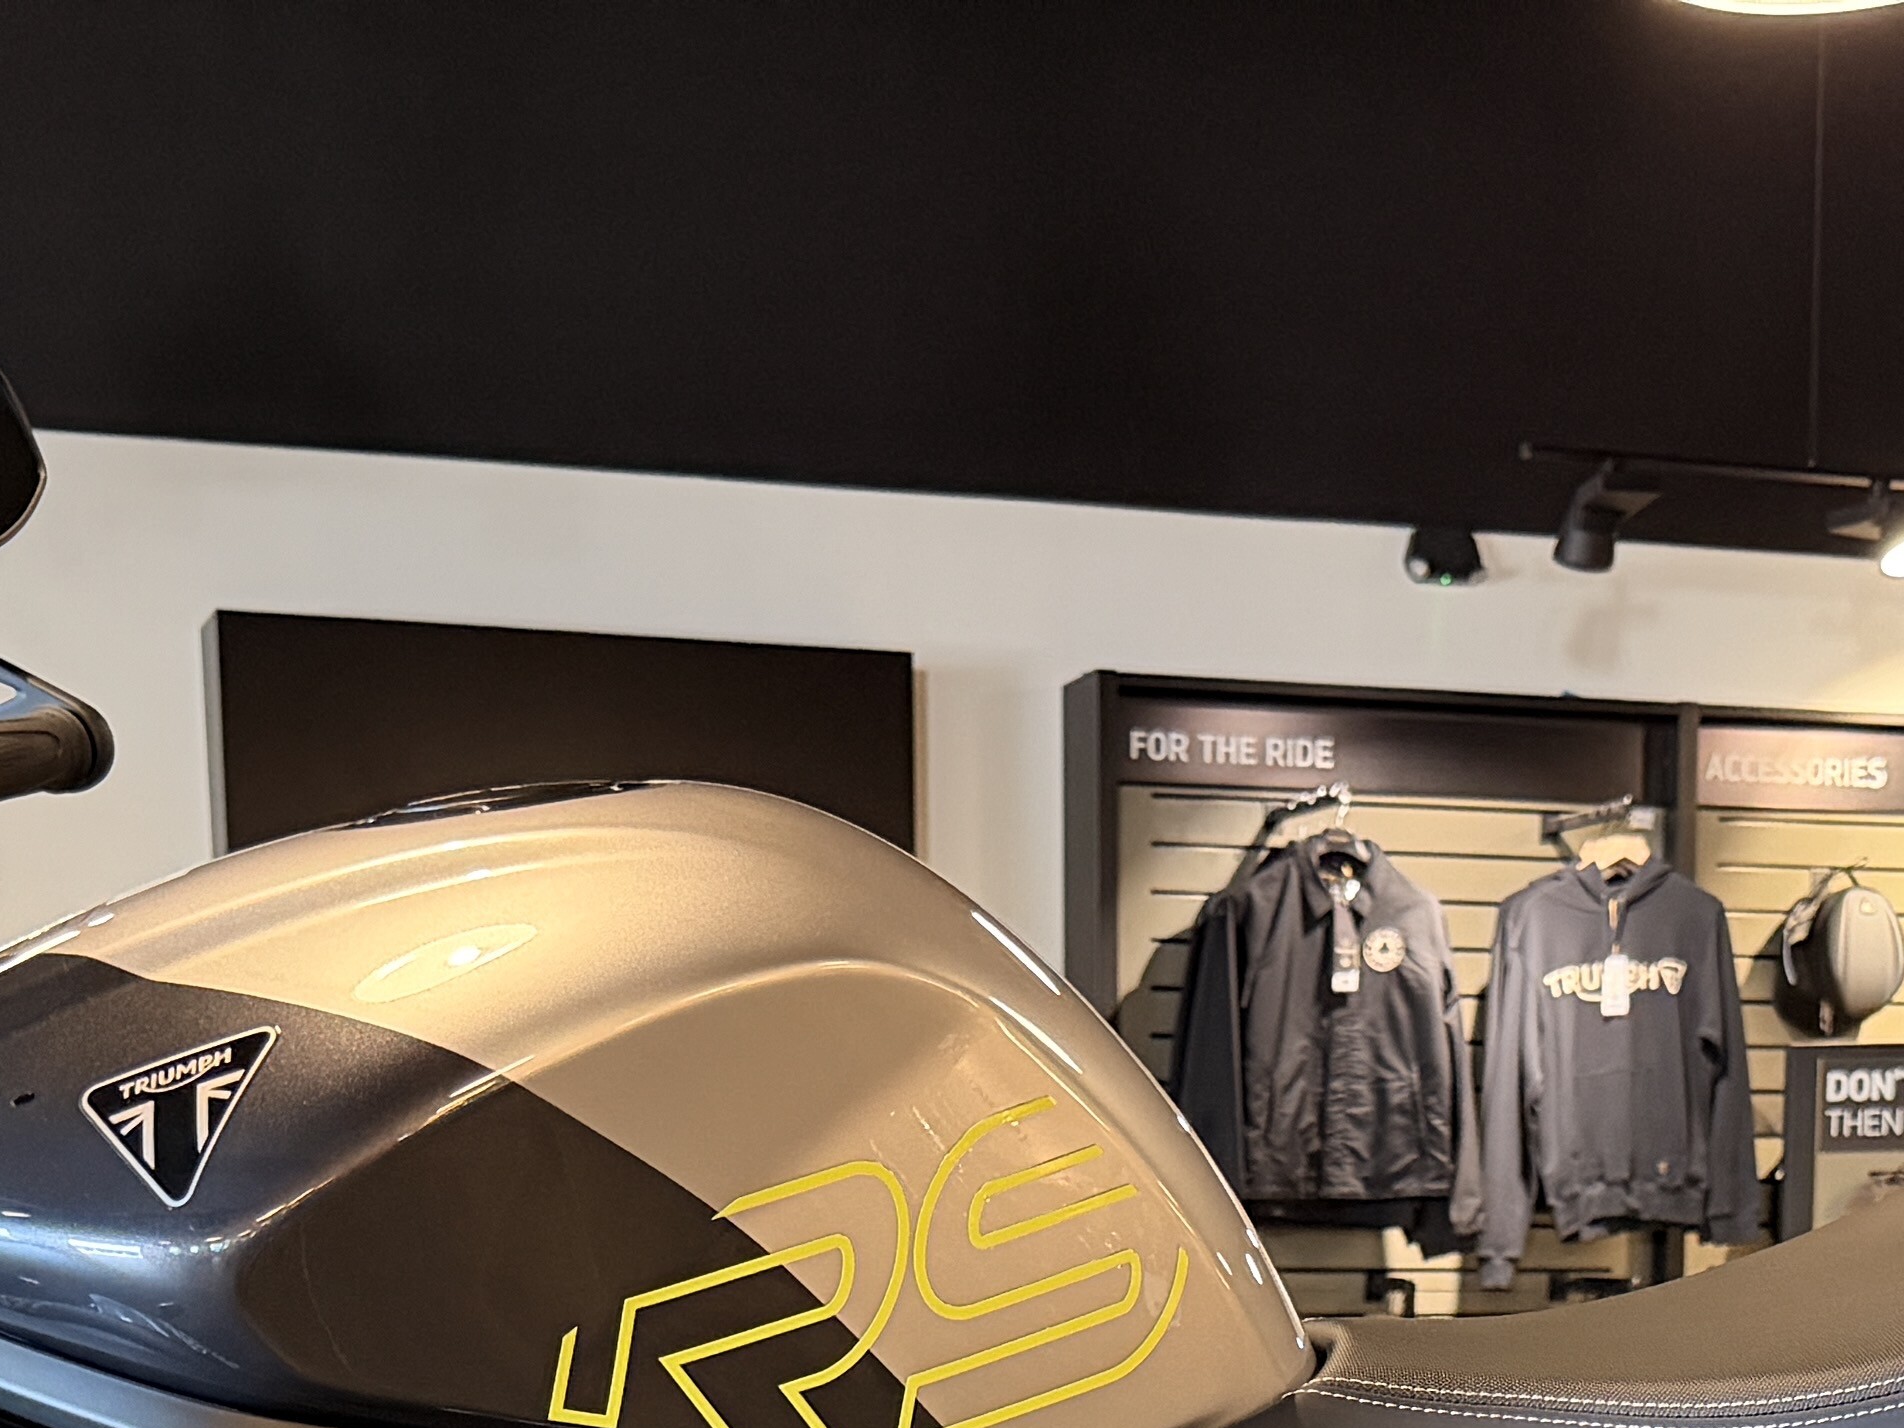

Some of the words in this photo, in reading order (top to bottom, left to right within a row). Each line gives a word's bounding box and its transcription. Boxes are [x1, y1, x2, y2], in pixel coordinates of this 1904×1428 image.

[1129, 729, 1189, 763] FOR
[1197, 734, 1259, 766] THE
[1265, 736, 1335, 769] RIDE
[1705, 752, 1888, 790] ACCESSORIES
[119, 1047, 232, 1099] TRIUMPH
[1824, 1107, 1904, 1138] THEN
